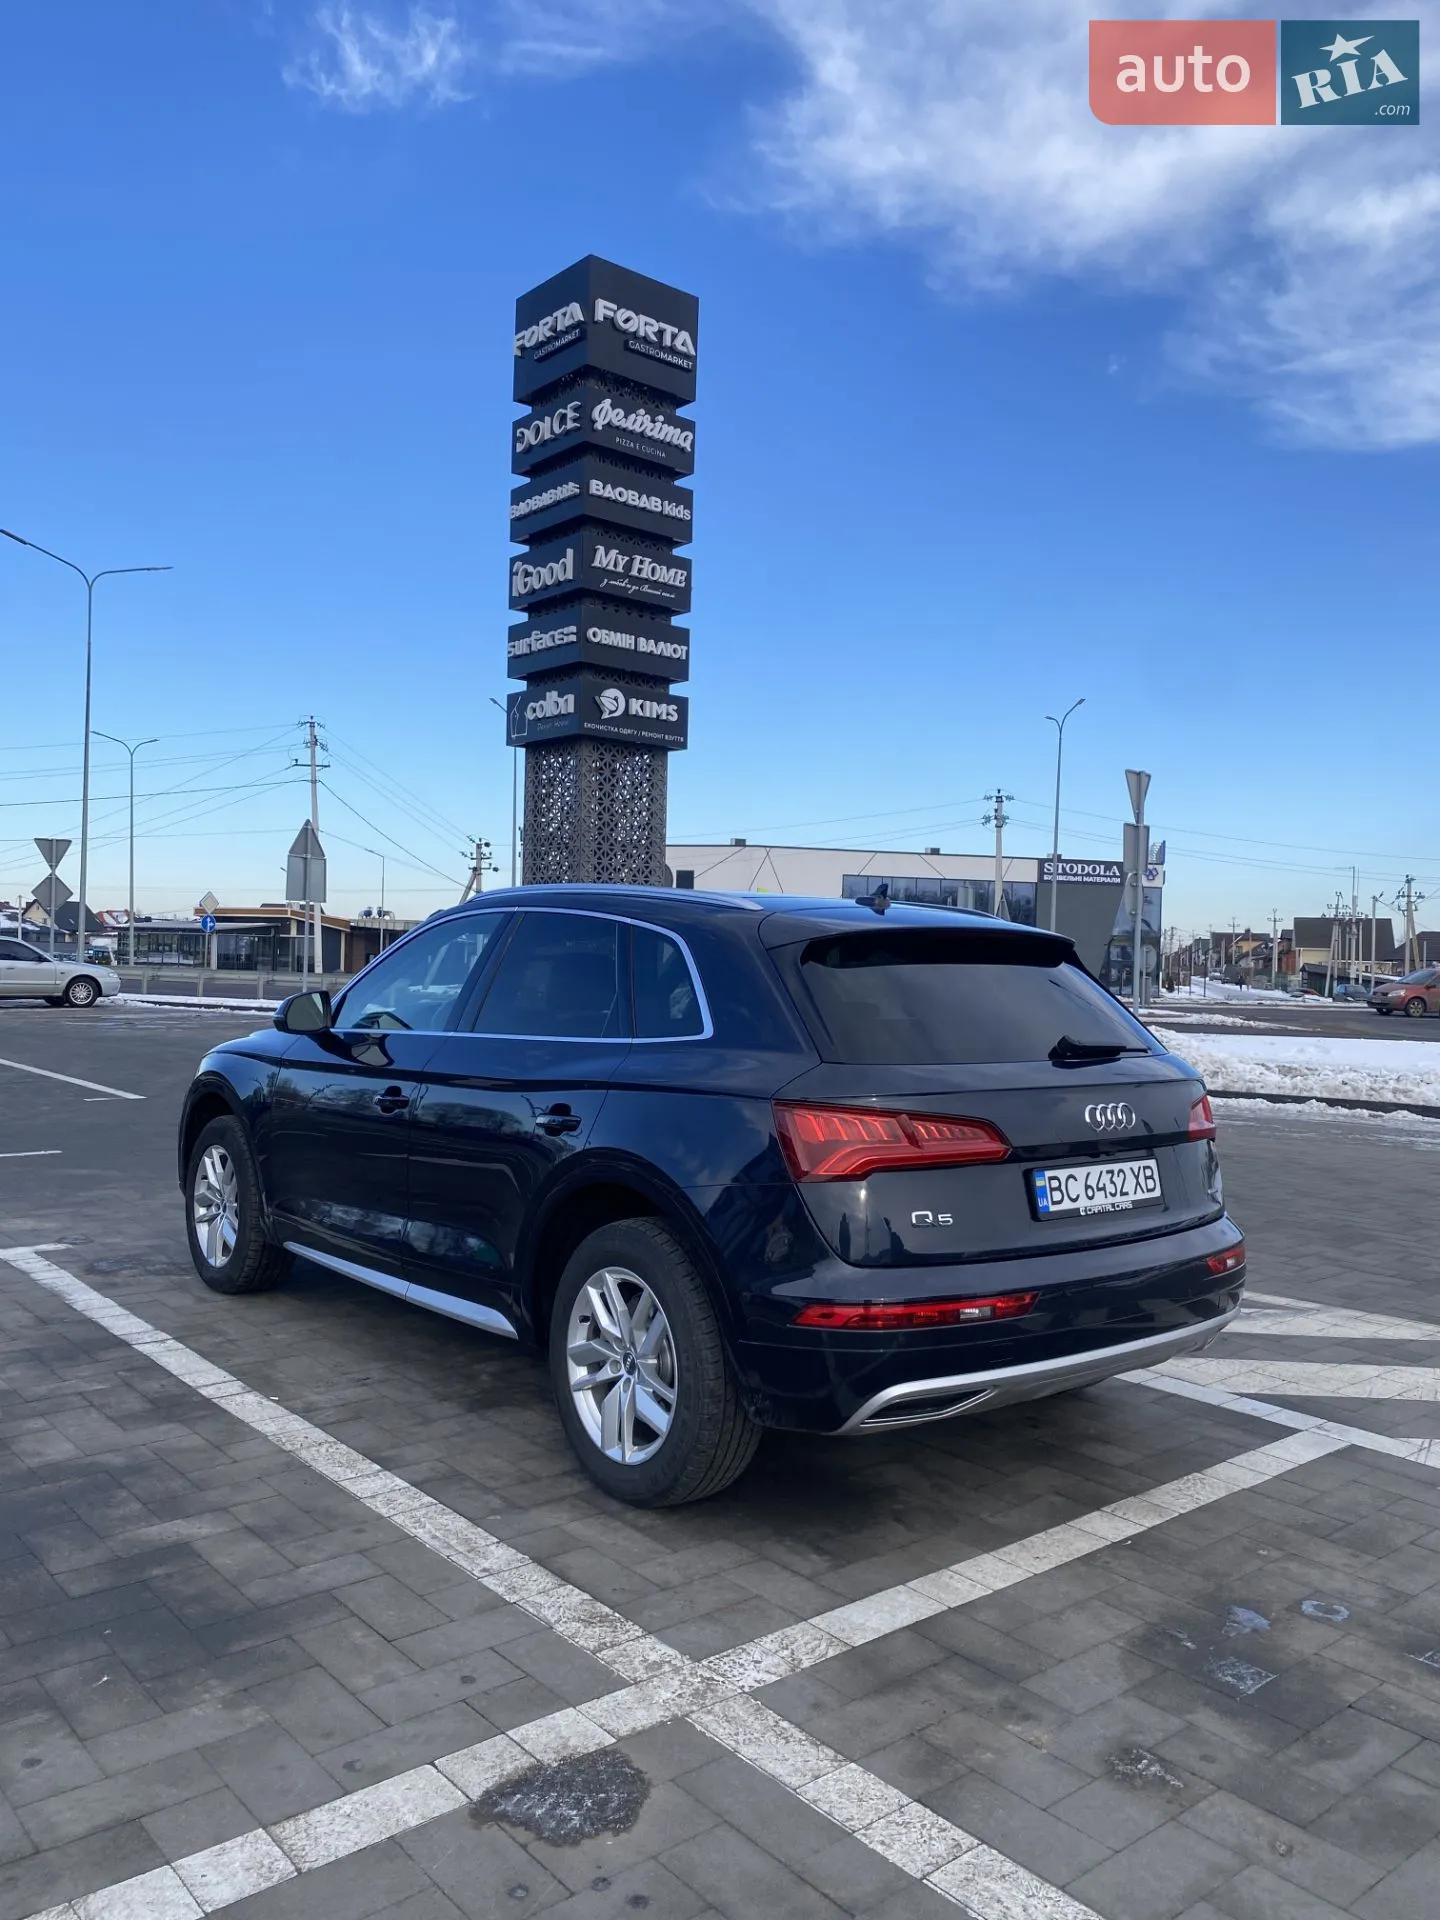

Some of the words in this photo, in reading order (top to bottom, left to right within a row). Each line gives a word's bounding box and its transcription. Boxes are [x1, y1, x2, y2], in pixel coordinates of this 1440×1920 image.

[514, 301, 585, 357] FORTA
[594, 298, 697, 356] FORTA
[533, 328, 581, 360] GASTROMARKET
[628, 340, 694, 370] GASTROMARKET
[515, 400, 582, 453] DOLCE
[615, 436, 634, 449] PIZZA
[641, 445, 666, 458] CUCINA
[588, 479, 662, 513] BAOBAB
[662, 500, 692, 521] kids
[512, 548, 574, 597] iGood
[586, 627, 635, 650] ОБМІН
[636, 637, 688, 660] ВАЛЮТ
[628, 697, 679, 722] KIMS
[583, 722, 618, 733] ЕКОЧИСТКА
[619, 728, 637, 737] ОДЯГУ
[641, 731, 664, 740] РЕМОНТ
[1044, 862, 1120, 876] STODOLA
[1047, 1173, 1080, 1206] BC
[1084, 1168, 1129, 1201] 6432
[1130, 1165, 1157, 1195] XB
[1038, 1198, 1048, 1207] UA
[1086, 1204, 1115, 1214] CAPITAL
[1115, 1200, 1133, 1211] CARS
[911, 1210, 954, 1228] Q5
